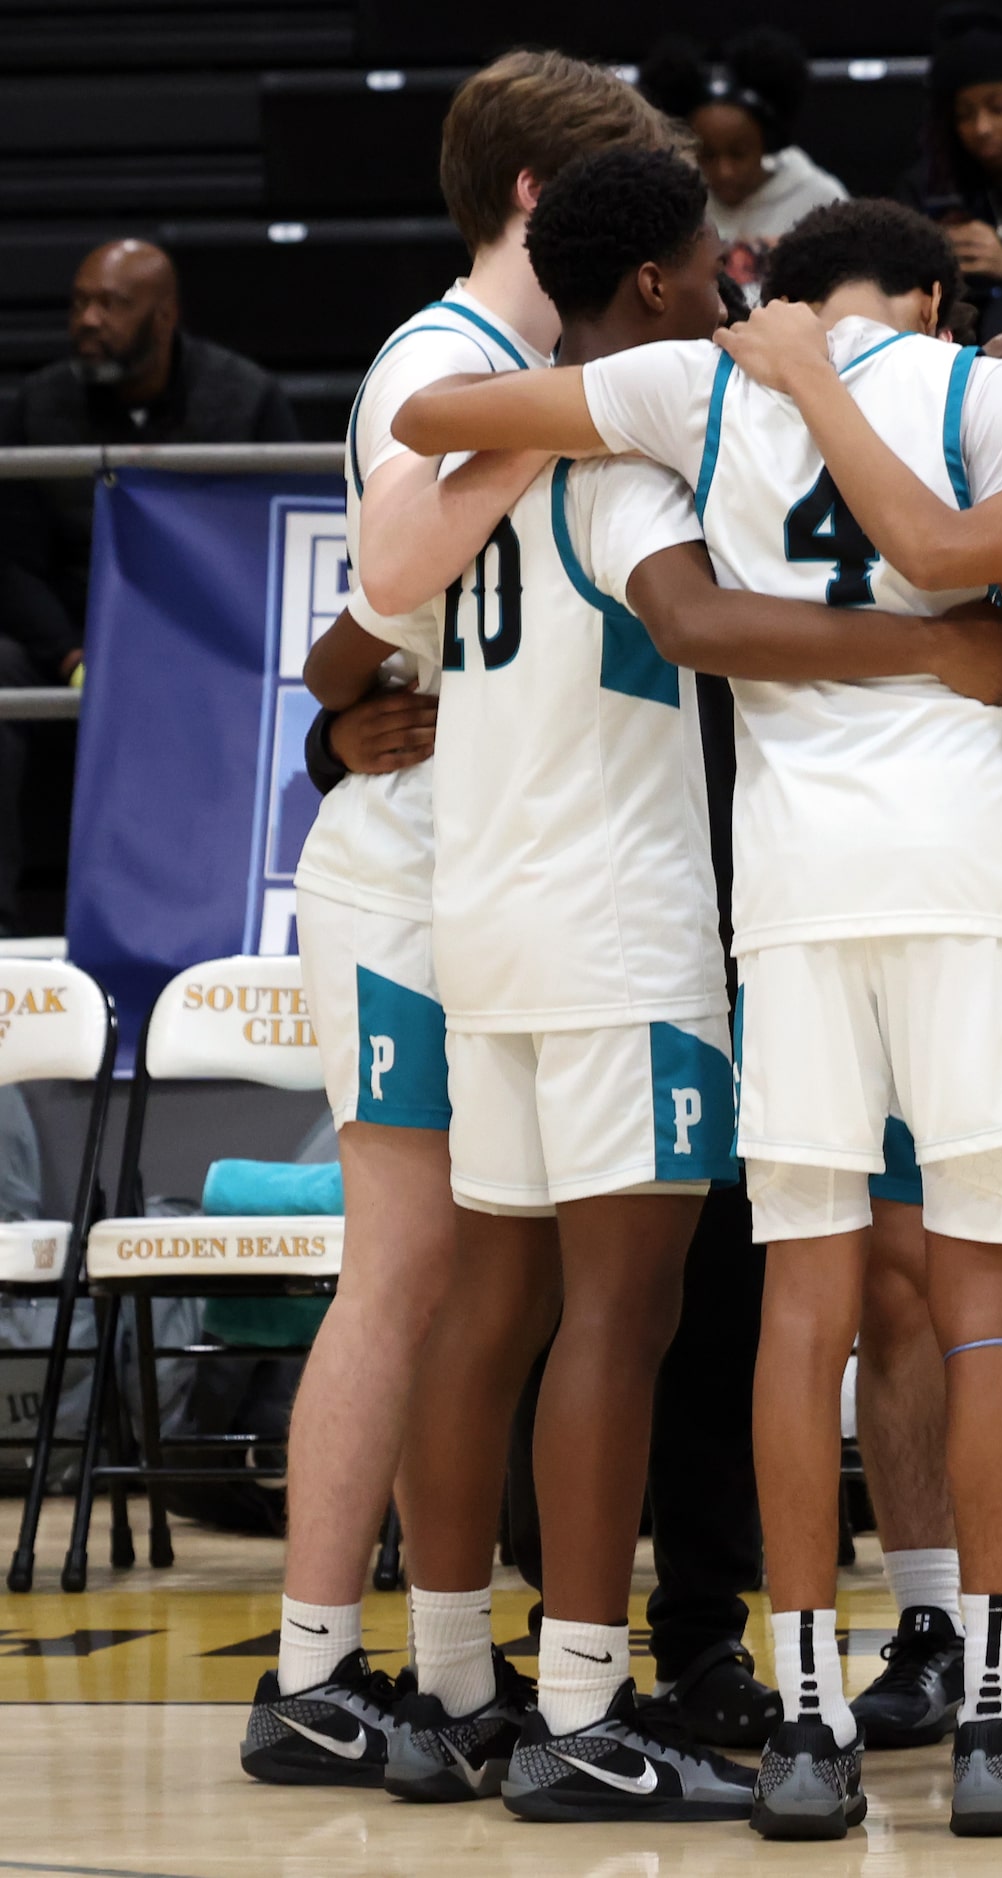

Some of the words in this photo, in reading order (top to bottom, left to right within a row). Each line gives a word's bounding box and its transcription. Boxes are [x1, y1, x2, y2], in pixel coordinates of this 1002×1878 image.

[783, 465, 880, 607] 4
[370, 1034, 395, 1100] P
[671, 1087, 702, 1155] P
[116, 1238, 226, 1260] GOLDEN
[236, 1236, 326, 1257] BEARS
